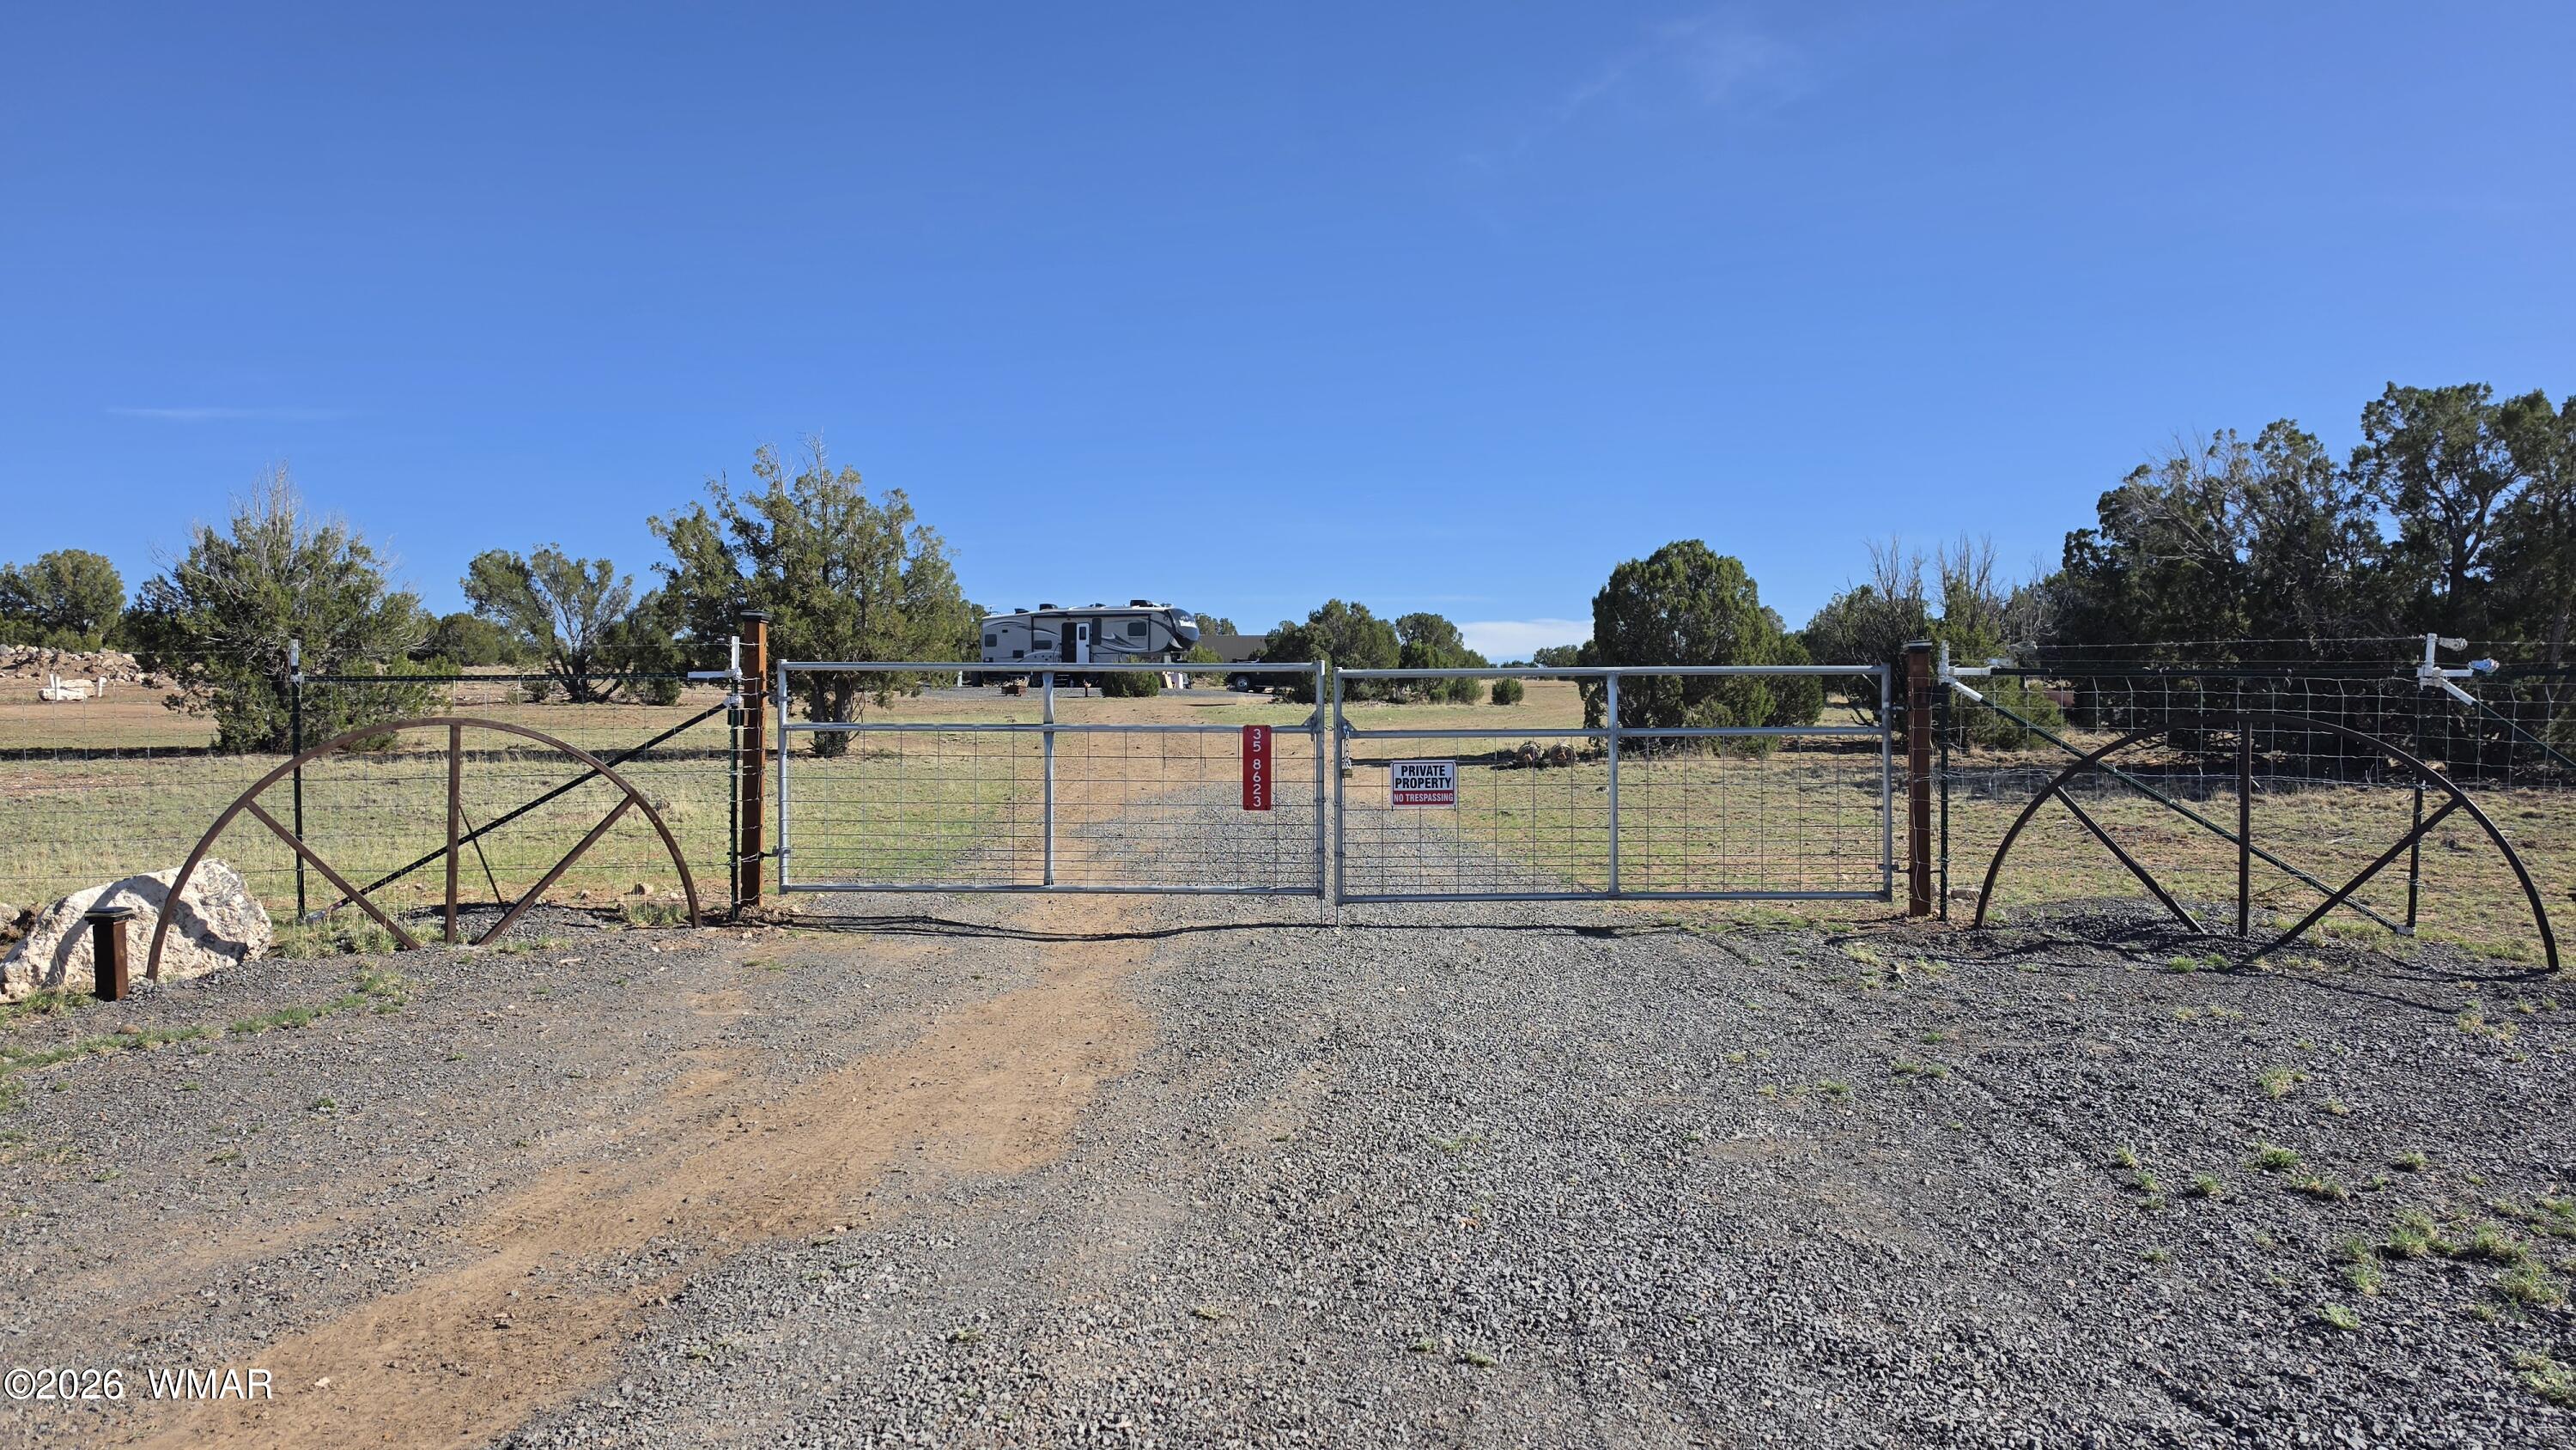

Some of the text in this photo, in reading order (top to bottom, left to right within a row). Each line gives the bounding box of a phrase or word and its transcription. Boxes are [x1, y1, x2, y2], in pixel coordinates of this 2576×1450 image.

[1253, 728, 1261, 807] 35 8623
[1400, 765, 1445, 777] PRIVATE
[1394, 777, 1451, 789] PROPERTY
[1394, 793, 1454, 803] NO TRESPASSING
